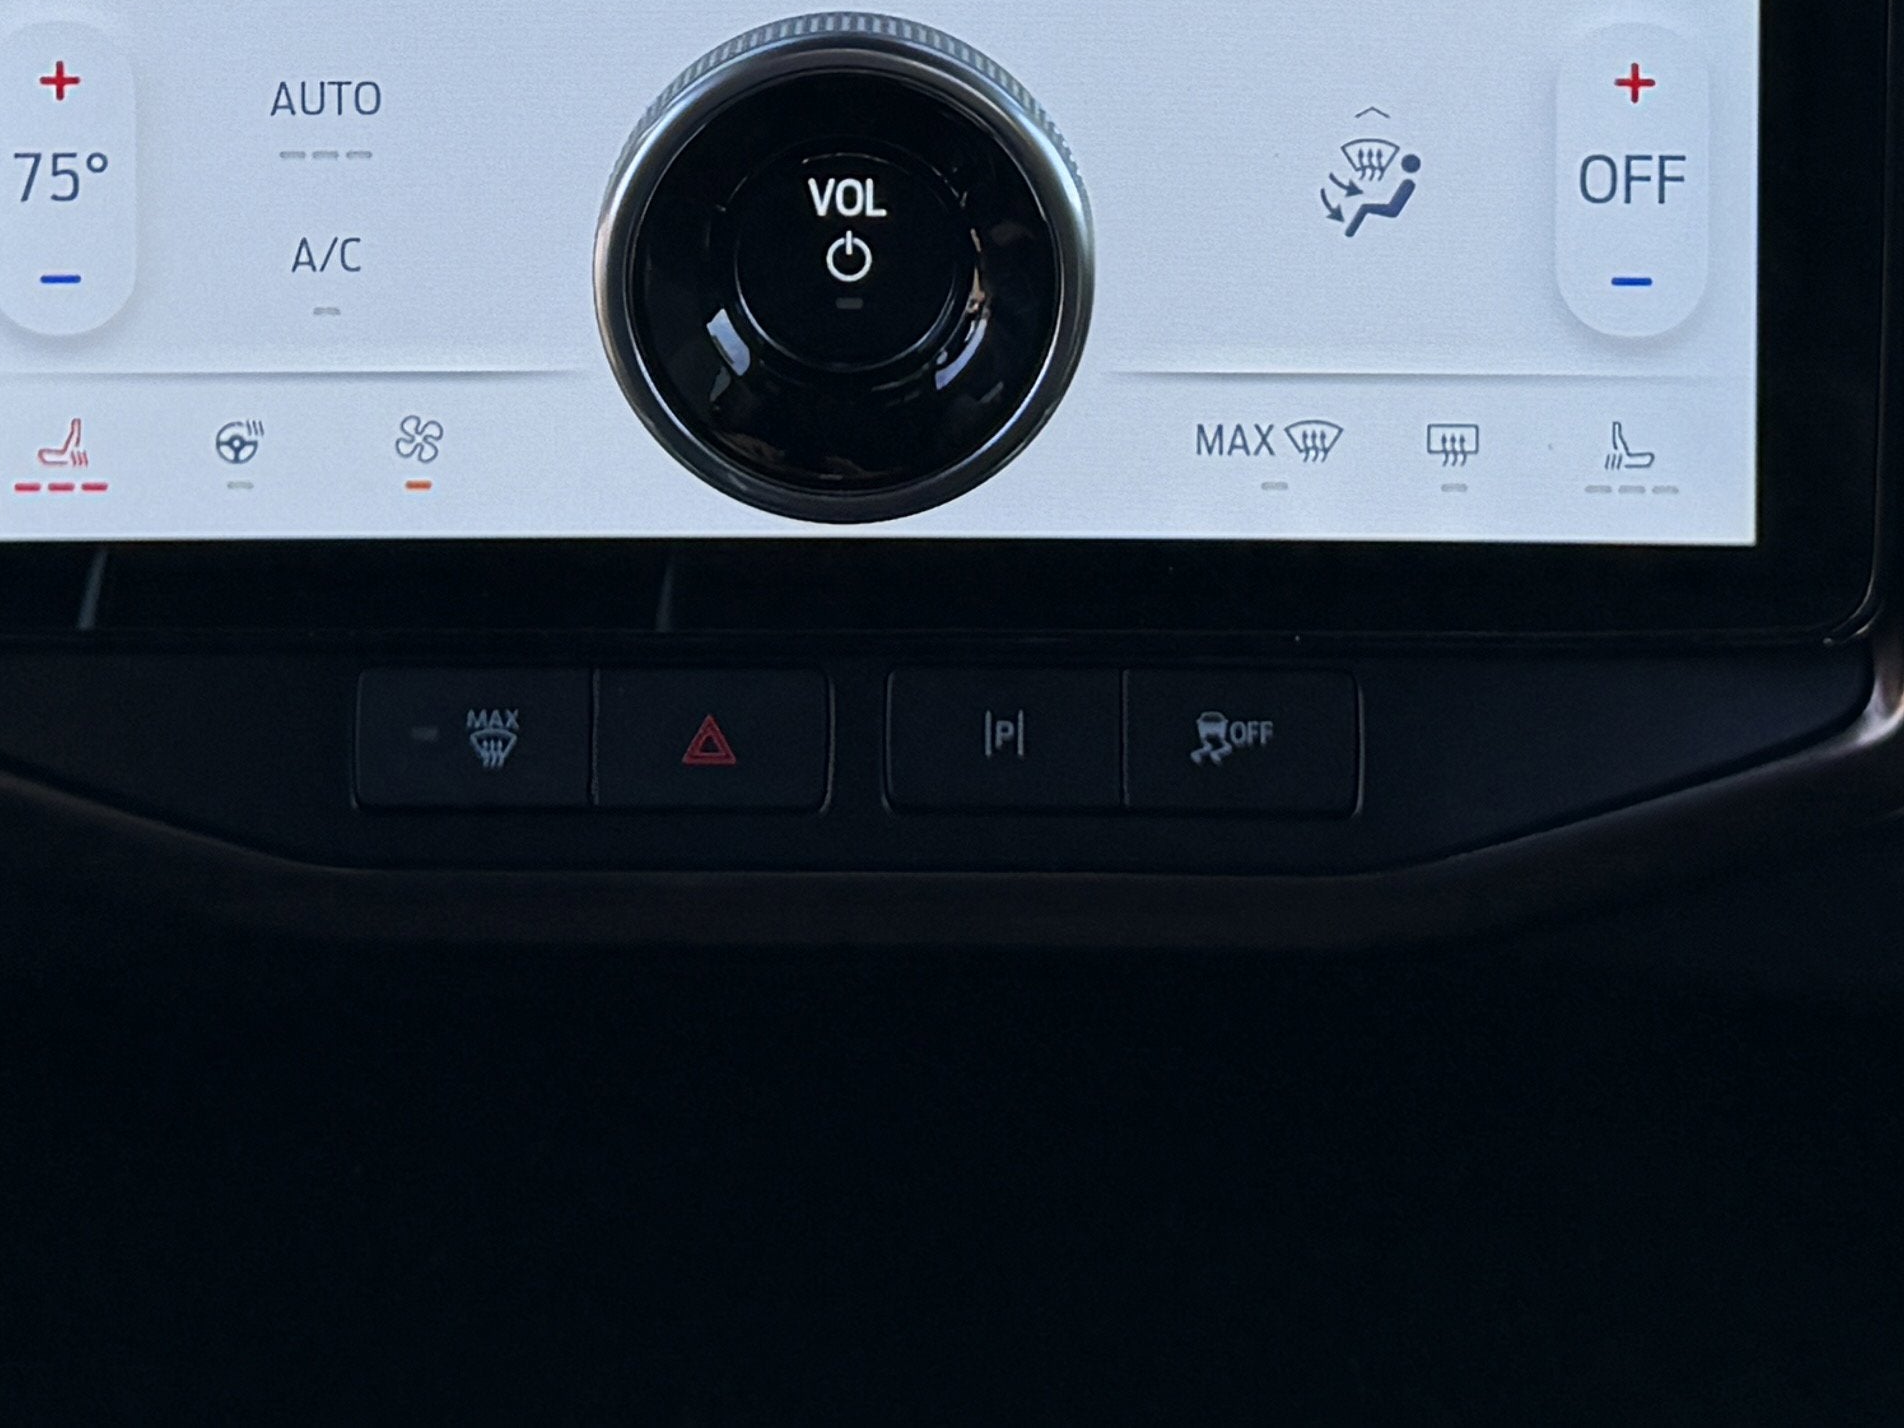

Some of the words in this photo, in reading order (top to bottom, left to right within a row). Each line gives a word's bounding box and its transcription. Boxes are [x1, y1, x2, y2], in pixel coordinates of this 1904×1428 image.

[270, 80, 382, 117] AUTO
[13, 152, 109, 203] 75°
[1579, 154, 1687, 205] OFF
[807, 178, 887, 217] VOL
[291, 236, 361, 273] A/C
[1196, 423, 1275, 456] MAX
[466, 709, 519, 730] MAX
[1230, 720, 1273, 748] OFF
